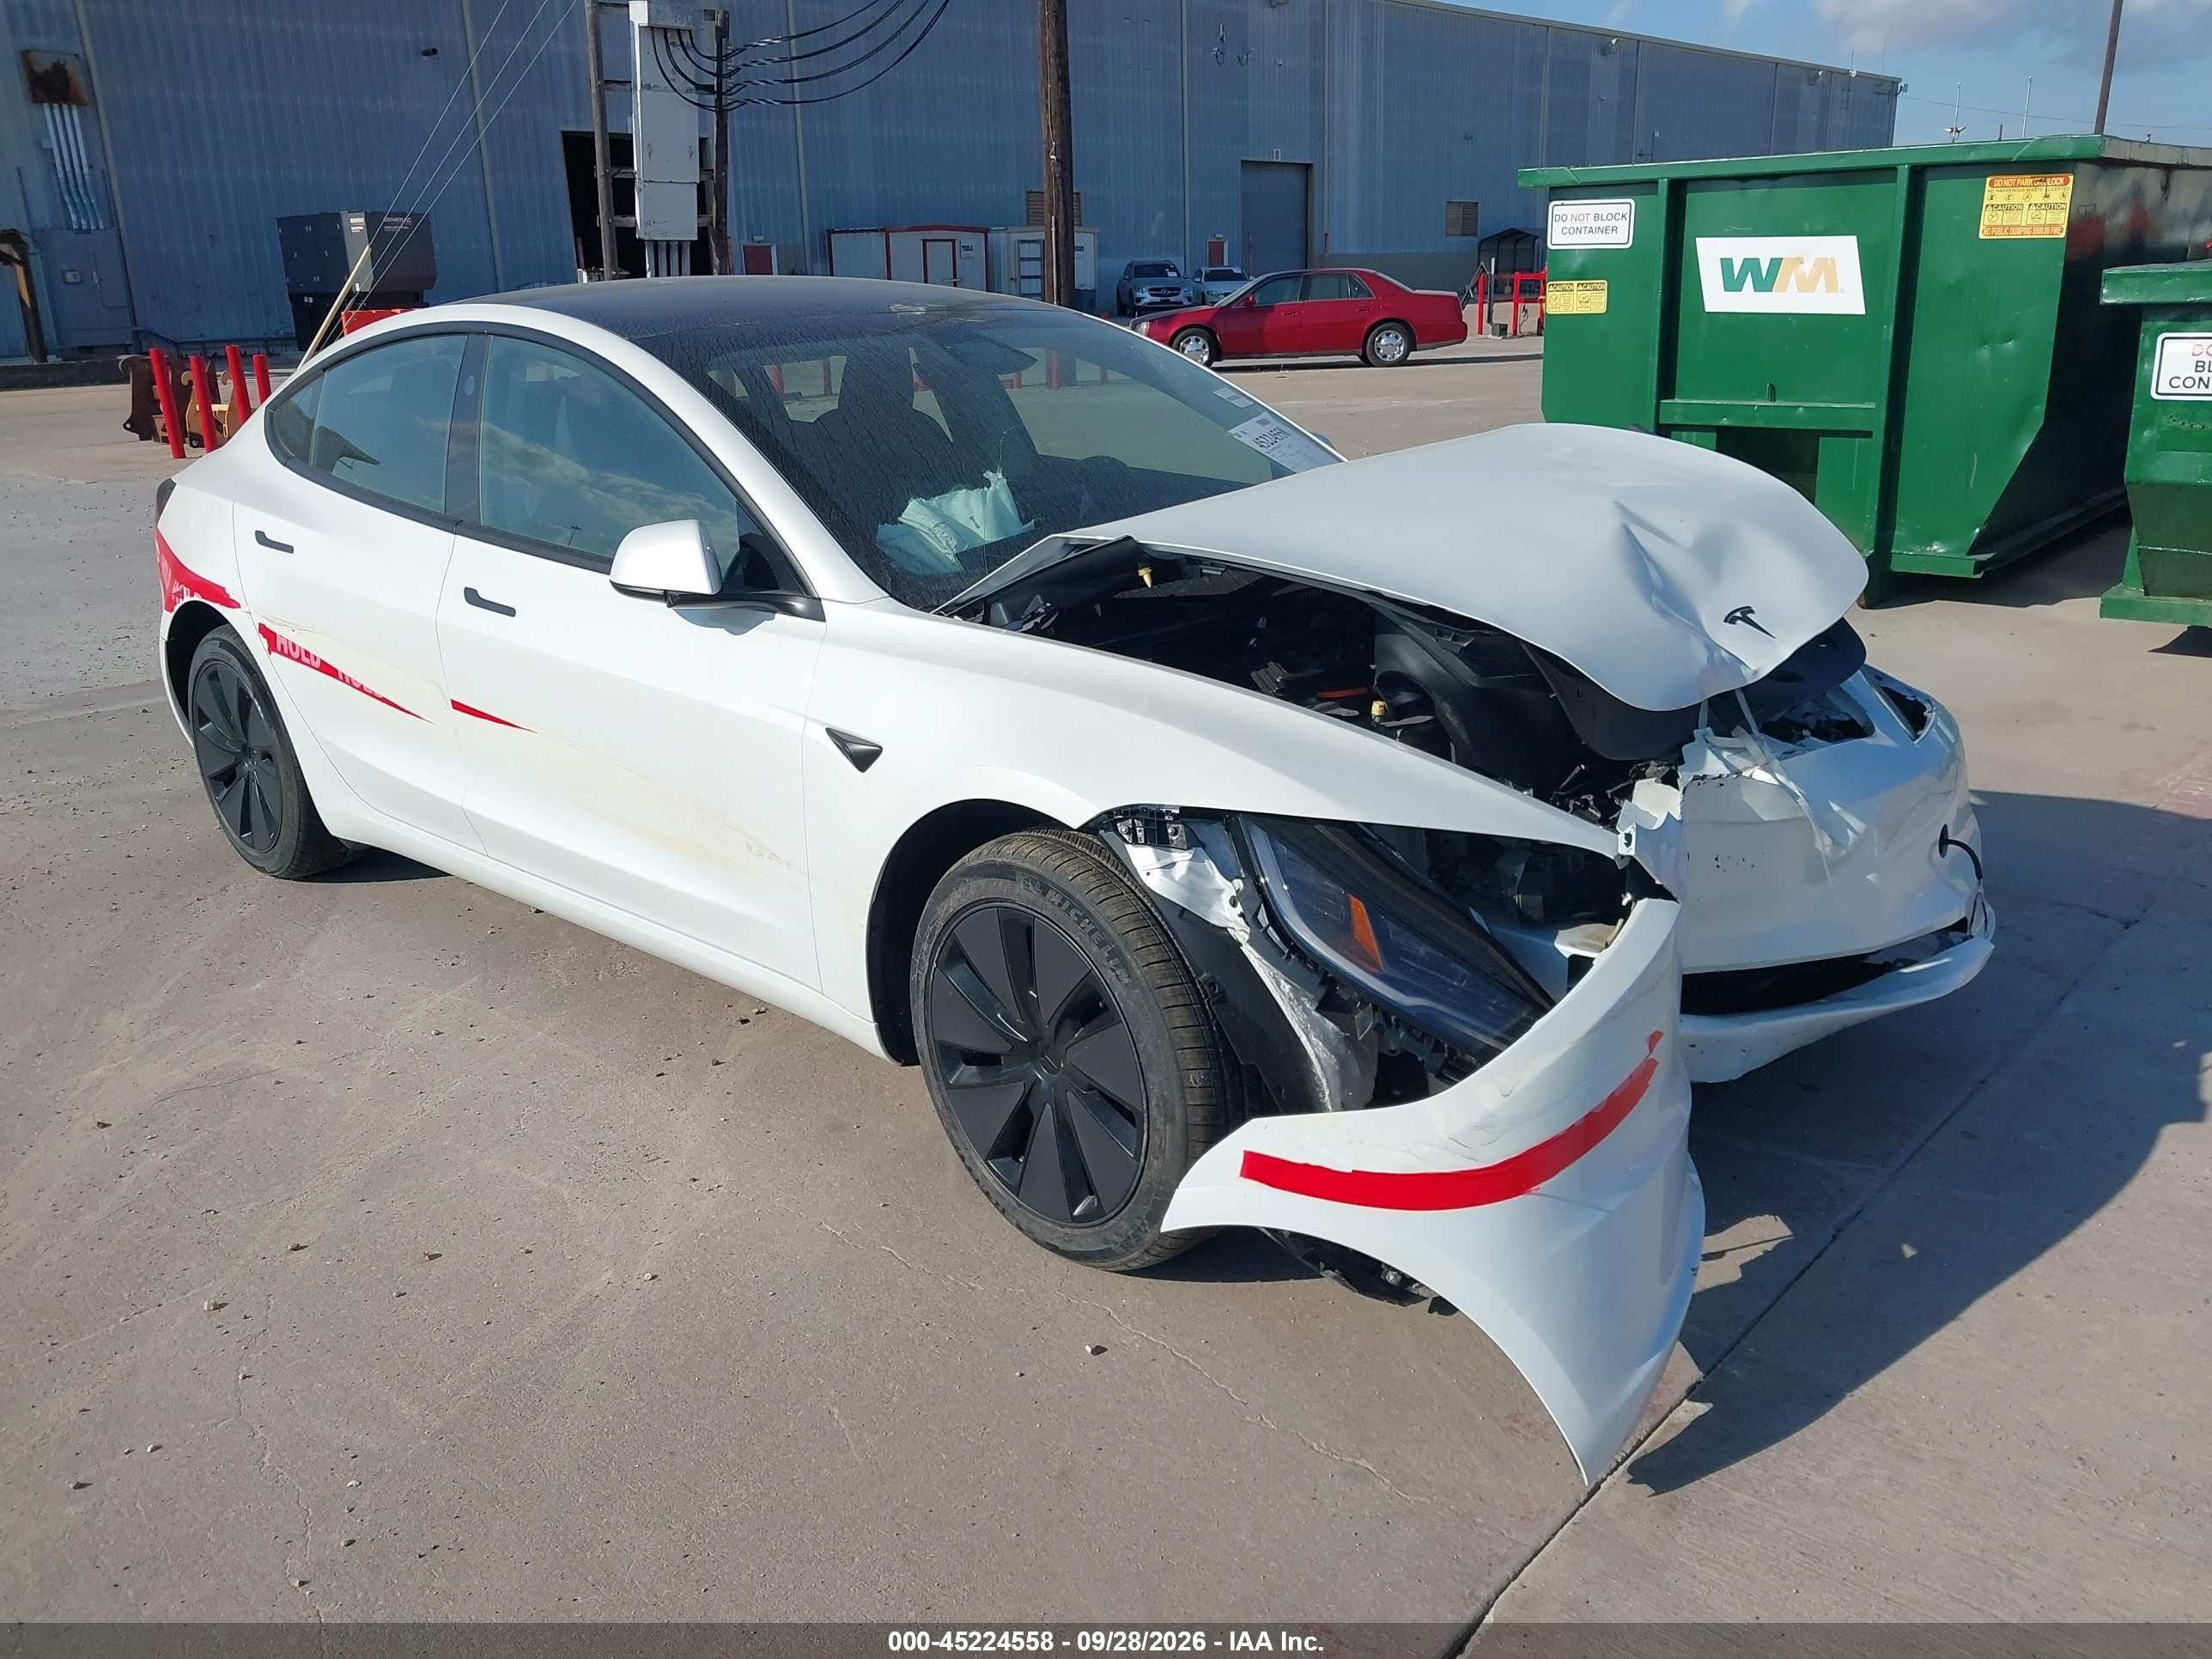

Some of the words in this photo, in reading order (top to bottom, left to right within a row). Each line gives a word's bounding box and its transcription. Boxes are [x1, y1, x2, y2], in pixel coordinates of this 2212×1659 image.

[2017, 178, 2033, 186] PARK
[1554, 214, 1568, 222] DO
[1571, 213, 1590, 222] NOT
[1593, 212, 1628, 222] BLOCK
[1561, 226, 1618, 235] CONTAINER
[1719, 257, 1840, 294] WM
[1583, 282, 1606, 290] CAUTION
